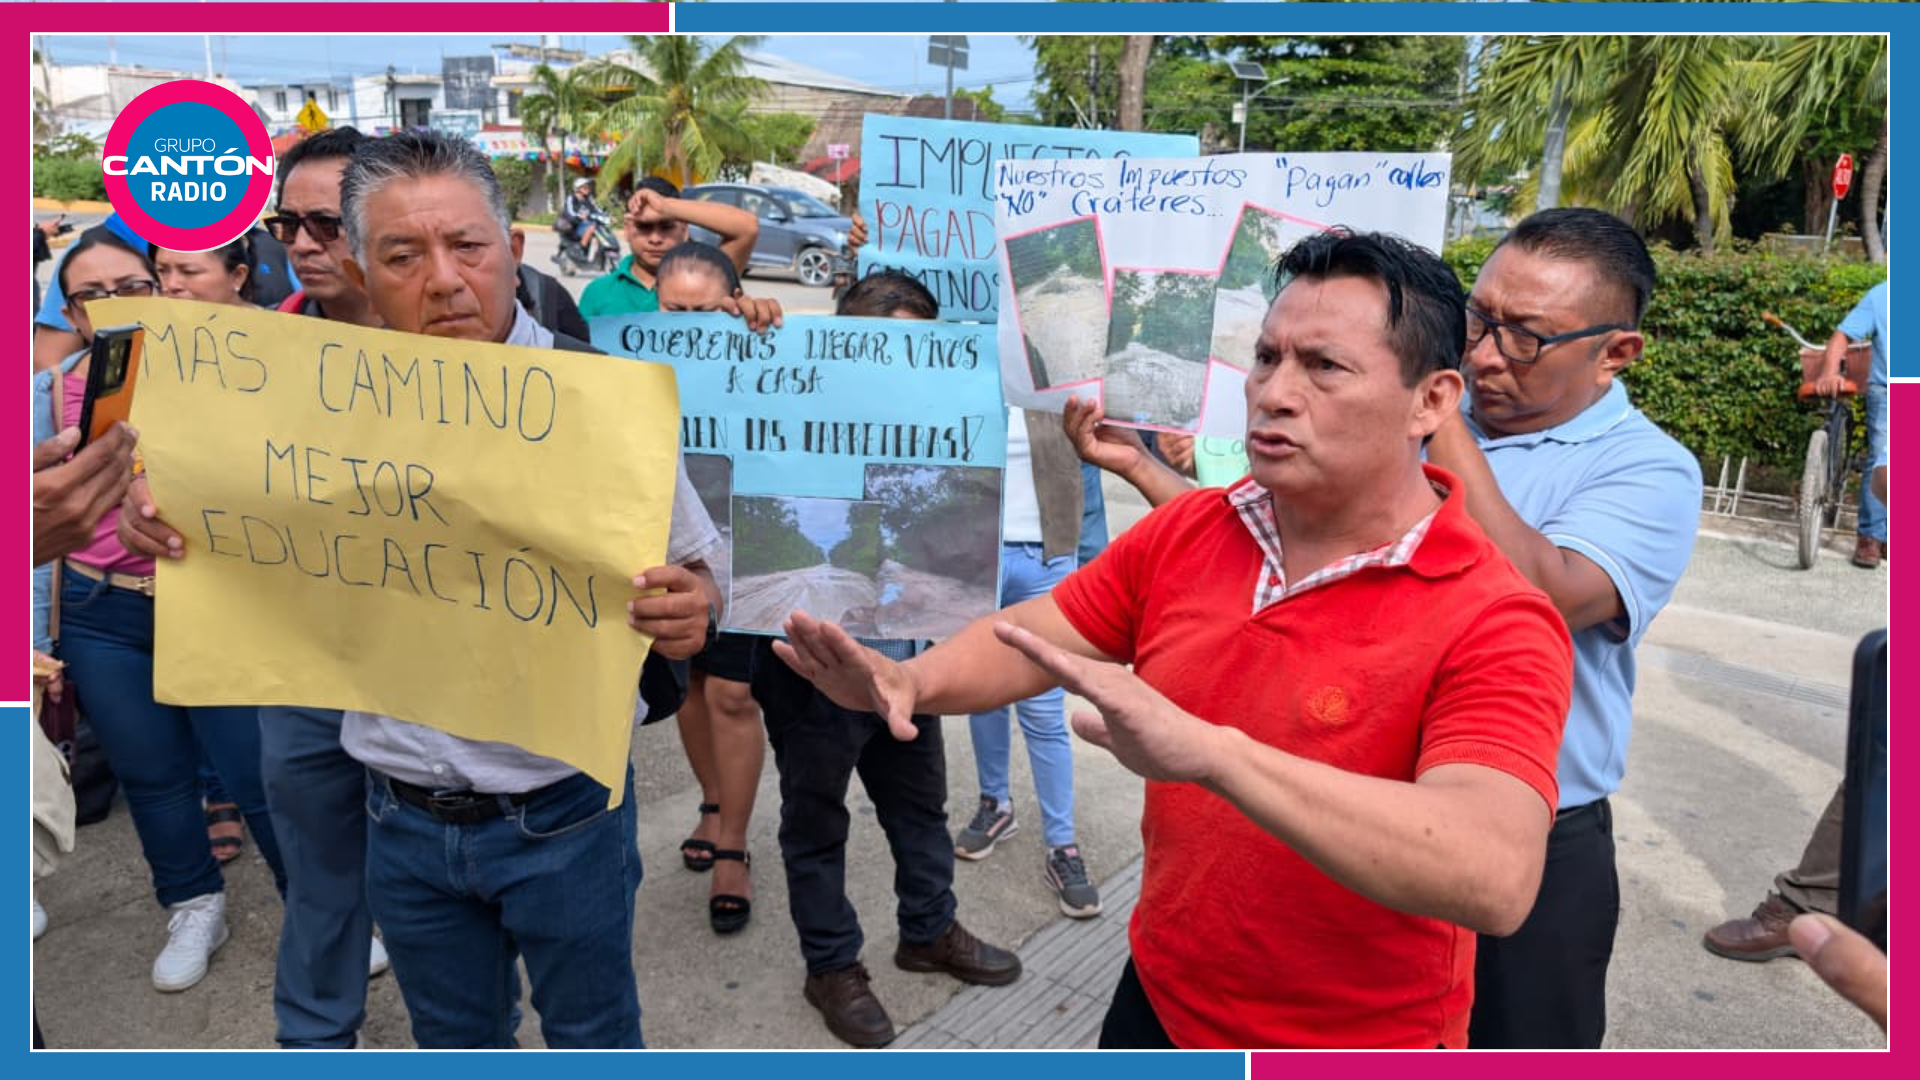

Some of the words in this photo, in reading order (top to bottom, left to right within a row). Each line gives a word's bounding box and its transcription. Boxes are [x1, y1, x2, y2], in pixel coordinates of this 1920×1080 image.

[999, 160, 1104, 189] Nuestros
[1119, 159, 1247, 193] Impuestos
[875, 198, 996, 260] PAGAD
[620, 324, 777, 361] QUEREMOS
[136, 313, 267, 393] MÁS
[319, 342, 556, 442] CAMINO
[725, 366, 745, 394] A
[756, 365, 825, 394] CASA
[745, 417, 788, 452] LAS
[803, 414, 985, 463] CARRETERAS!
[266, 438, 449, 526] MEJOR
[202, 509, 598, 629] EDUCACIÓN
